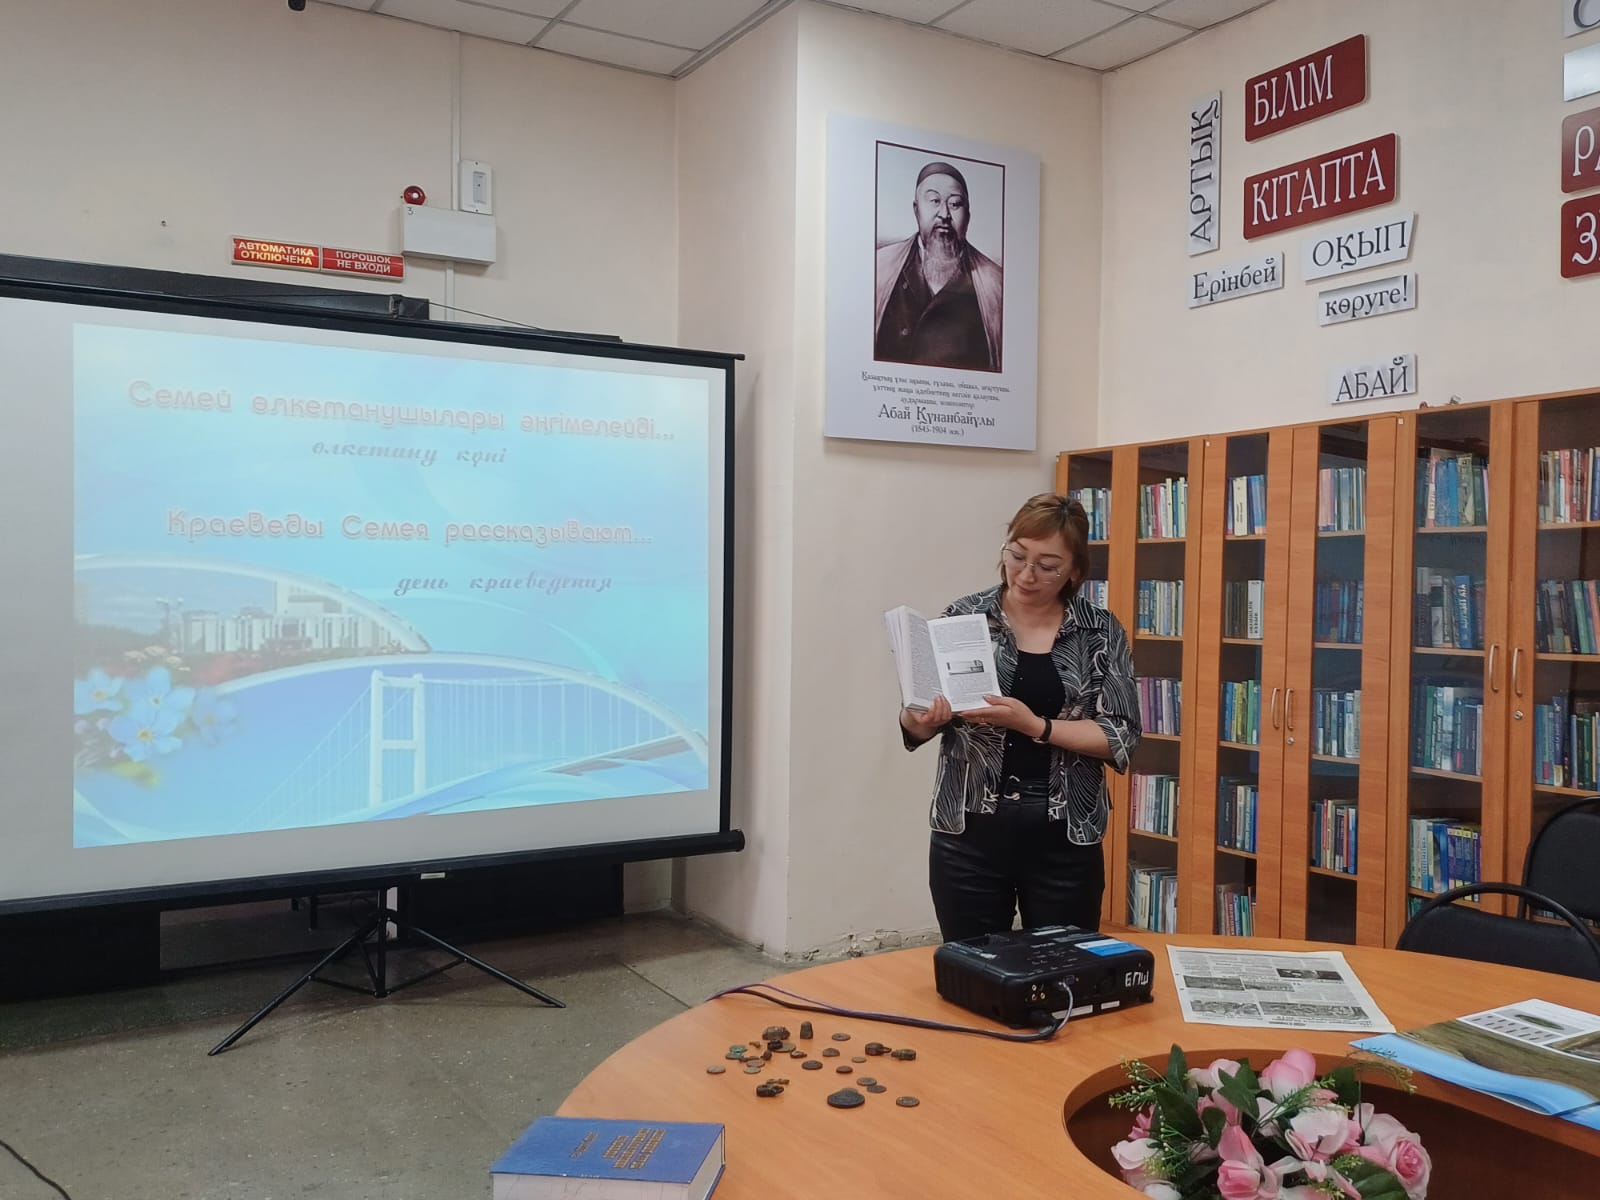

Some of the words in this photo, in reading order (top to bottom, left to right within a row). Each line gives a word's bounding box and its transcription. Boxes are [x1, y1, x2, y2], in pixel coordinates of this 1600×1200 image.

[1254, 55, 1333, 126] БІЛІМ
[1190, 99, 1219, 242] АРТЫҚ
[1252, 147, 1386, 226] КІТАПТА
[239, 241, 315, 257] АВТОМАТИКА
[240, 250, 313, 266] ОТКЛЮЧЕНА
[335, 250, 392, 265] ПОРОШОК
[1312, 220, 1407, 270] ОҚЫП
[336, 259, 352, 270] НЕ
[354, 261, 391, 274] ВХОДИ
[1193, 257, 1276, 301] Ерінбей
[1325, 275, 1408, 318] көруге!
[1336, 356, 1408, 402] АБАЙ
[128, 379, 232, 412] Семей
[251, 395, 504, 434] өлкетанушылары
[878, 403, 911, 420] Абай
[312, 441, 438, 467] өлкетану
[167, 509, 325, 543] Краеведы
[341, 514, 429, 541] Семея
[394, 576, 449, 597] день
[469, 569, 612, 596] краеведения
